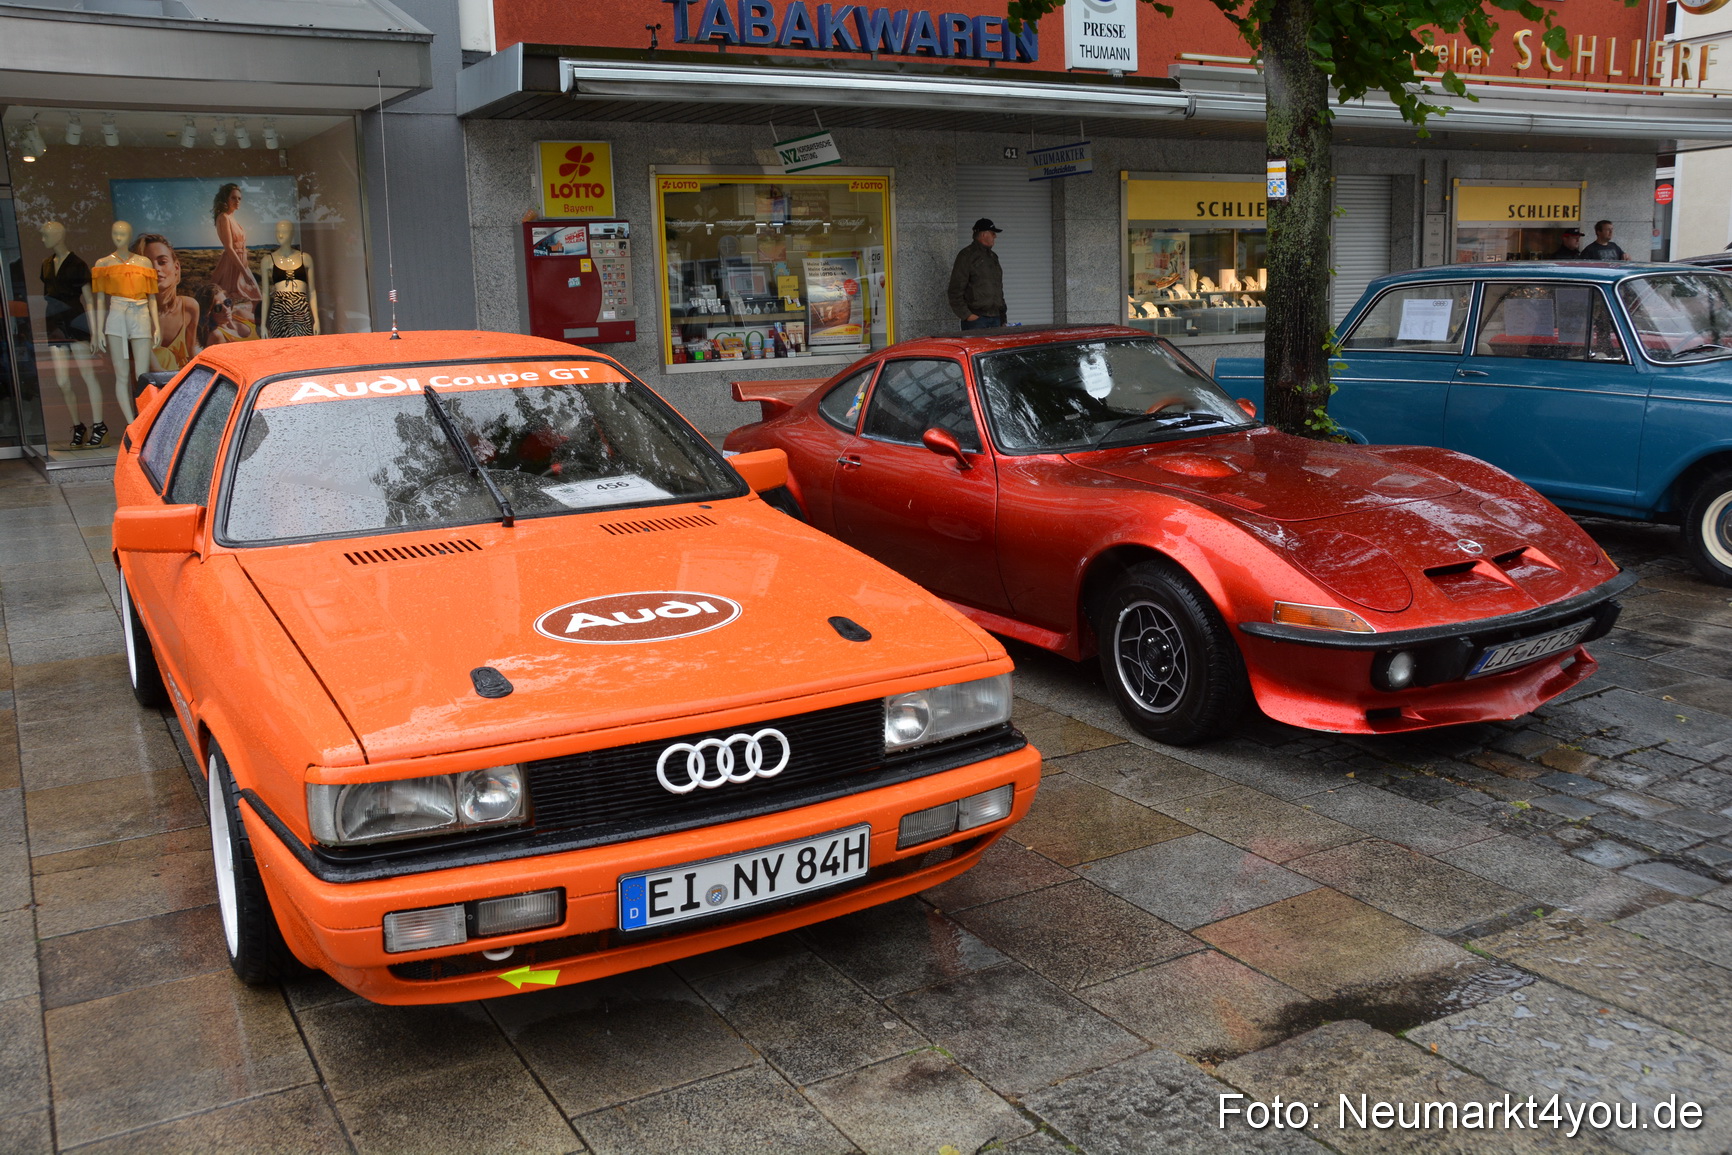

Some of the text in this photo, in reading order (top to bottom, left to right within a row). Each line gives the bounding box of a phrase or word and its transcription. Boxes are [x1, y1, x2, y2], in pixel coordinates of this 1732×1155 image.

[662, 0, 1038, 62] TABAKWAREN
[1083, 21, 1126, 39] PRESSE
[1079, 44, 1131, 61] THUMANN
[1512, 29, 1719, 81] SCHLIERF
[780, 140, 832, 165] NZ NORDBAYERISCHE
[800, 152, 819, 162] ZEITUNG
[1005, 148, 1017, 158] 41
[1033, 147, 1085, 167] NEUMARKTER
[1043, 164, 1077, 176] Nachrichten
[550, 183, 605, 199] LOTTO
[672, 181, 698, 189] LOTTO
[564, 204, 594, 214] Bayern
[1196, 201, 1265, 217] SCHLIE
[1508, 204, 1579, 218] SCHLIERF
[429, 371, 539, 388] Coupe
[549, 367, 590, 380] GT
[597, 481, 630, 491] 456
[1482, 644, 1526, 669] LIF
[1527, 637, 1553, 657] GT
[649, 833, 866, 918] EI NY 84H
[630, 908, 639, 919] D
